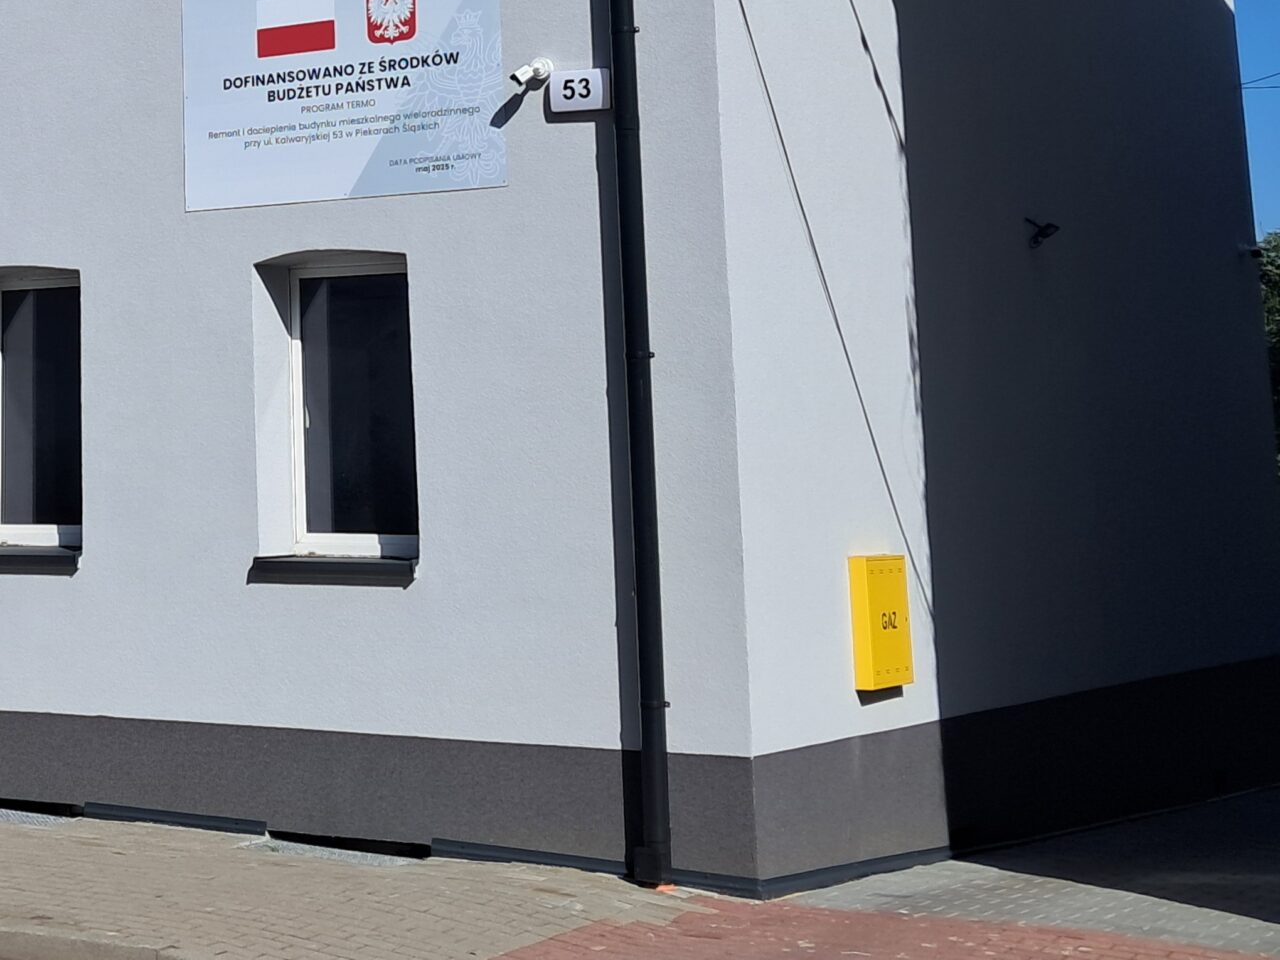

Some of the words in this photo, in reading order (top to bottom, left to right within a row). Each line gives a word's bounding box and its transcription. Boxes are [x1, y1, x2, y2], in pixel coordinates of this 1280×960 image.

[223, 64, 355, 90] DOFINANSOWANO
[359, 61, 375, 75] ZE
[379, 51, 460, 72] ŚRODKÓW
[267, 84, 332, 102] BUDŻETU
[335, 75, 411, 95] PAŃSTWA
[562, 77, 591, 100] 53
[301, 101, 344, 114] PROGRAM
[347, 99, 376, 110] TERMO
[208, 129, 241, 140] Remont
[299, 120, 337, 133] budynku
[338, 113, 401, 126] mieszkalnego
[403, 106, 481, 120] wielorodzinnego
[244, 139, 261, 150] przy
[275, 132, 331, 145] Kalwaryjskiej
[332, 130, 344, 139] 53
[355, 124, 400, 137] Piekarach
[402, 121, 440, 133] Śląskich
[415, 164, 431, 173] maj
[881, 611, 898, 630] GAZ
